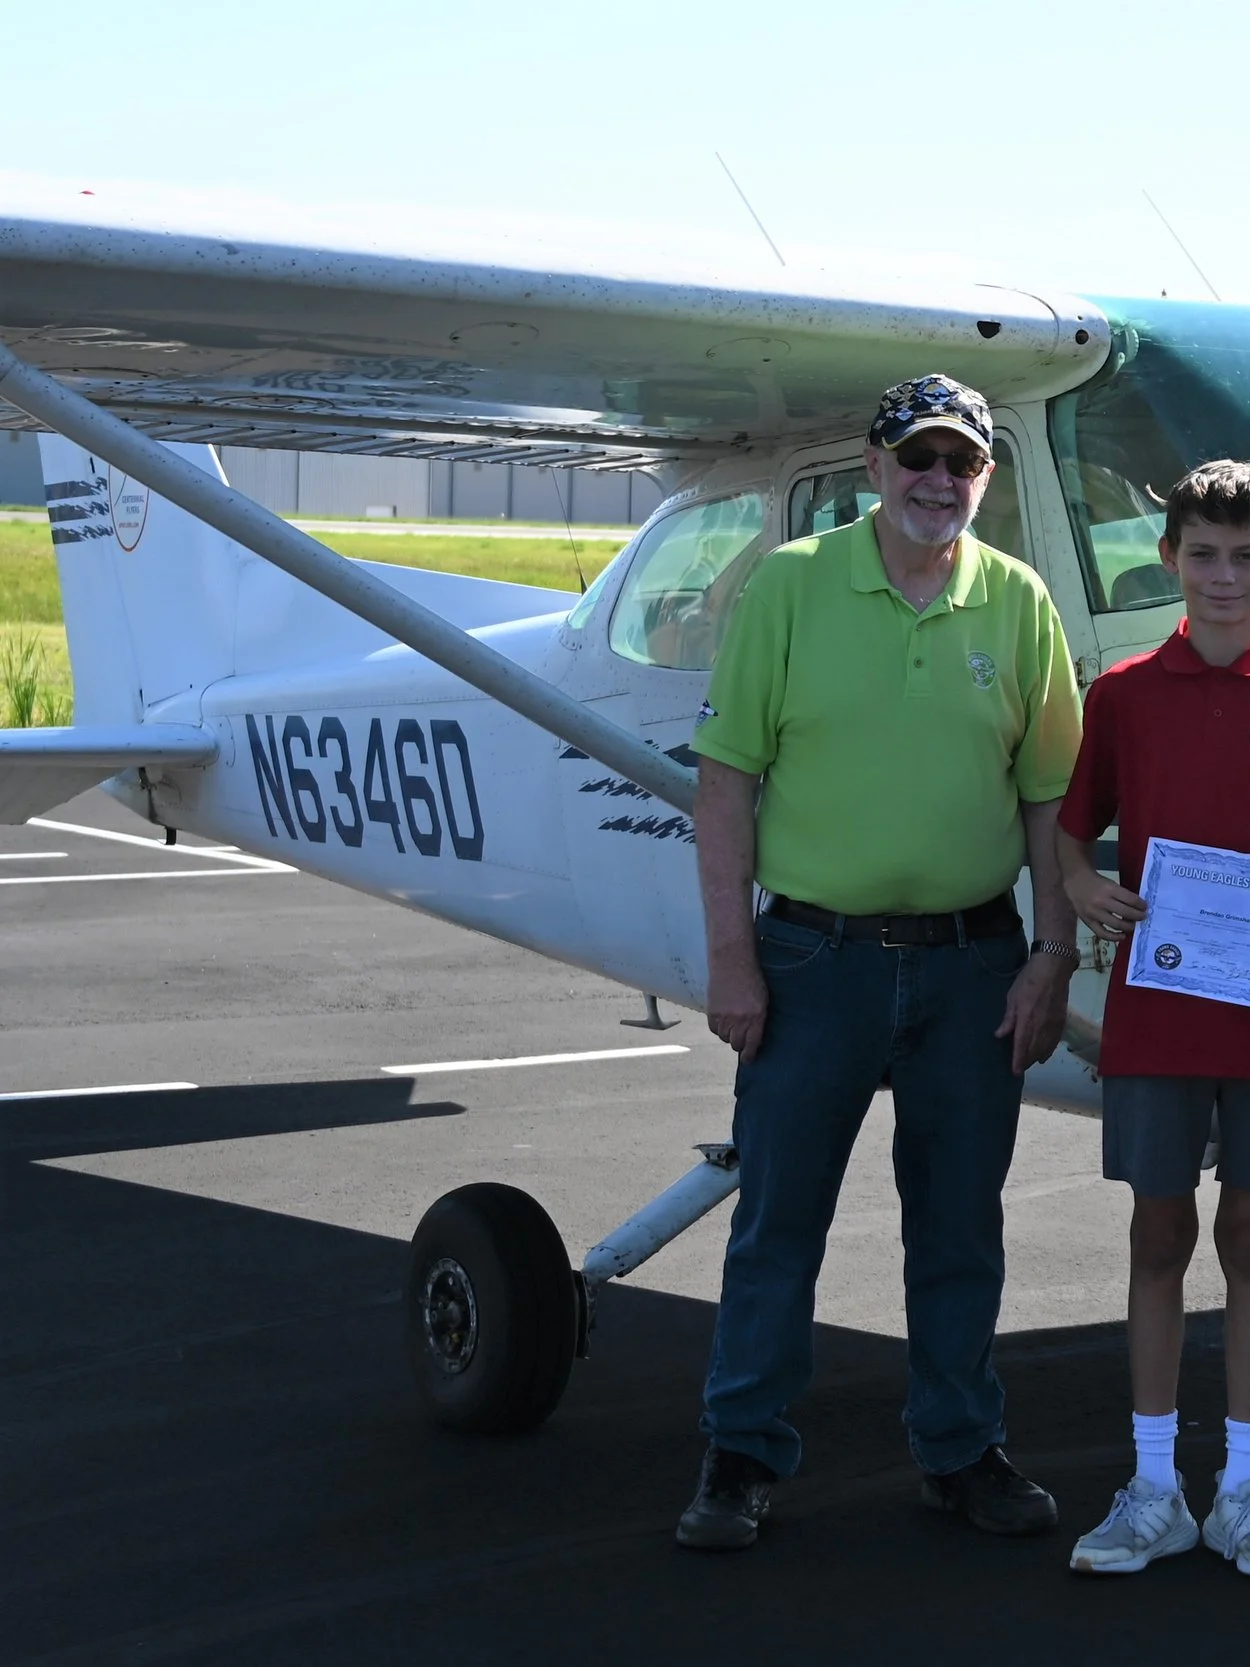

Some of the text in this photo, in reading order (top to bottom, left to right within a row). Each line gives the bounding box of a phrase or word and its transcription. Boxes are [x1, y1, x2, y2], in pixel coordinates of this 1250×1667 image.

[245, 714, 485, 861] N6346D
[1171, 864, 1209, 881] YOUNG
[1210, 871, 1250, 889] EAGLES
